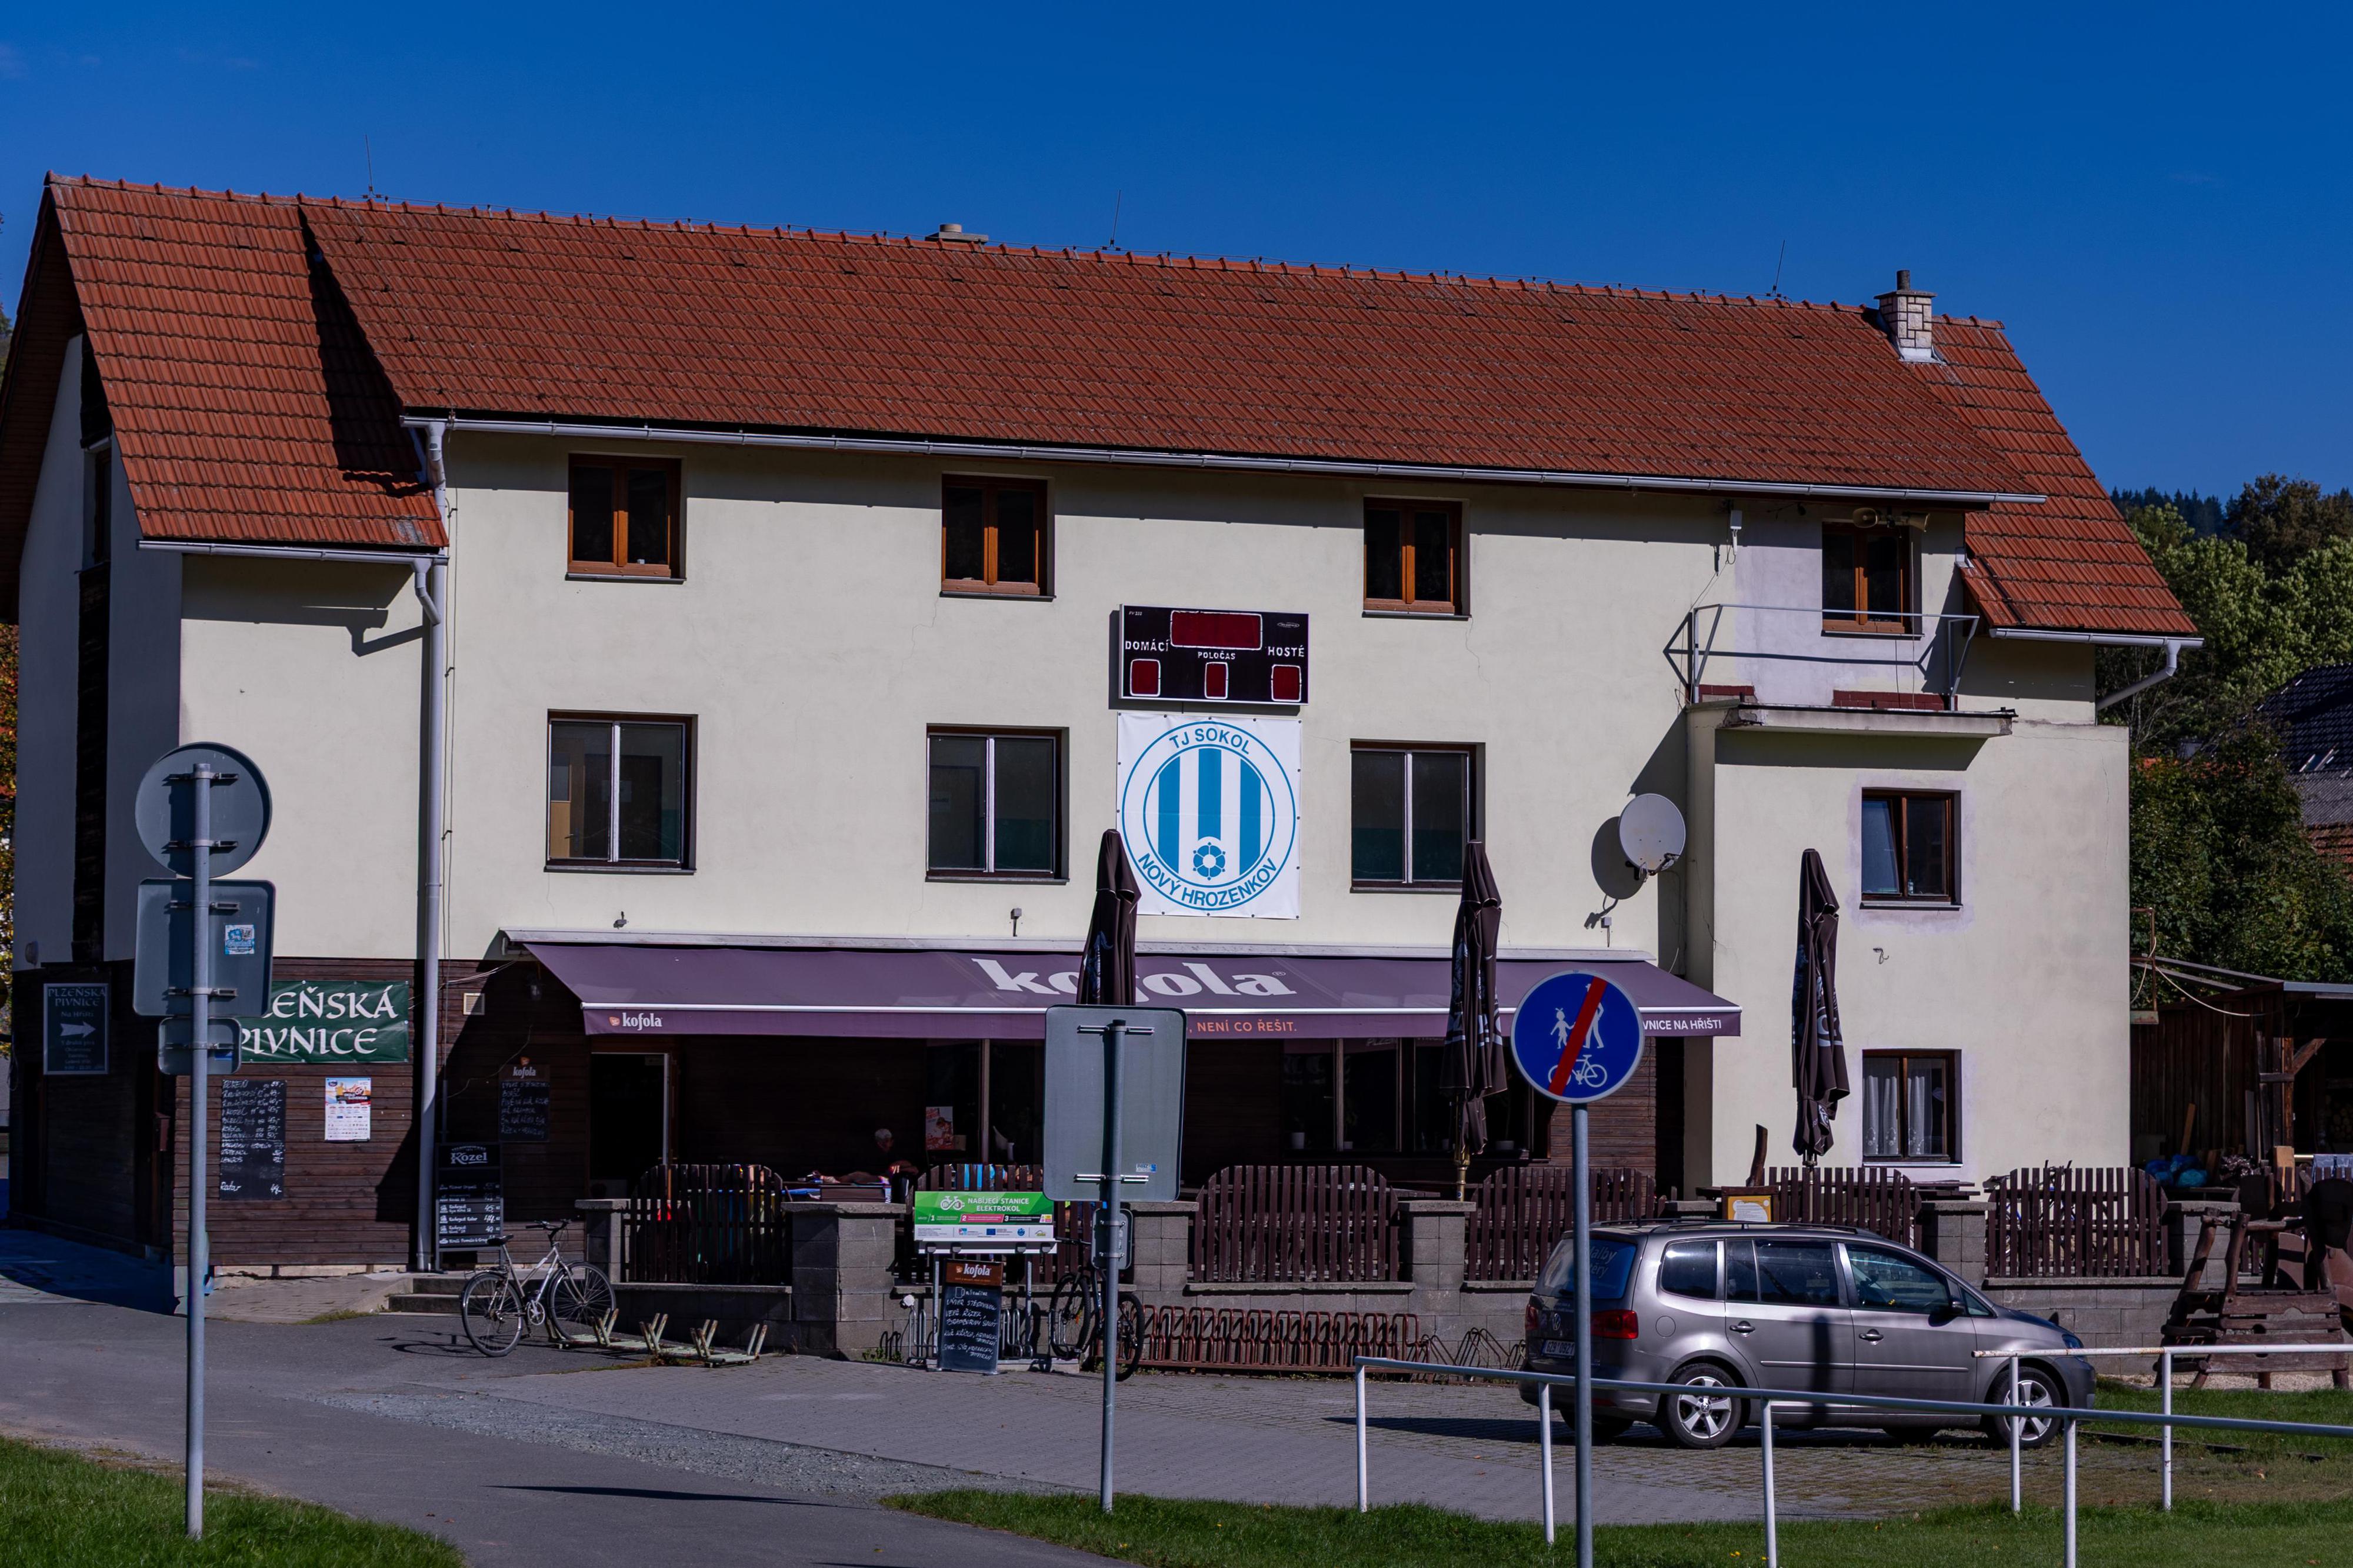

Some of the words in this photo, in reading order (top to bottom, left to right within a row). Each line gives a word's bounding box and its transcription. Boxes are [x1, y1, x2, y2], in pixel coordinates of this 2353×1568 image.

[1125, 639, 1170, 652] DOMÁCÍ
[1268, 645, 1305, 658] HOSTÉ
[1198, 650, 1236, 661] POLOČAS
[1169, 735, 1189, 749] TJ
[1195, 728, 1251, 755] SOKOL
[1138, 853, 1181, 896] NOVÝ
[1181, 858, 1277, 907] HROZENKOV
[971, 958, 1298, 1003] koola
[55, 997, 101, 1007] PIVNICE
[261, 985, 399, 1019] EŇSKÁ
[622, 1012, 663, 1031] kofola
[1197, 1019, 1229, 1032] NENÍ
[1234, 1022, 1252, 1032] CO
[1258, 1019, 1297, 1032] ŘEŠIT.
[1643, 1019, 1672, 1030] VNICE
[1674, 1019, 1688, 1030] NA
[1690, 1017, 1722, 1030] HŘIŠTI
[512, 1066, 536, 1079] kofola
[451, 1152, 488, 1165] Kozel
[968, 1196, 998, 1205] NABÍJECÍ
[976, 1205, 1021, 1213] ELEKTROKOL
[1590, 1245, 1618, 1265] alby
[964, 1263, 991, 1278] kofola
